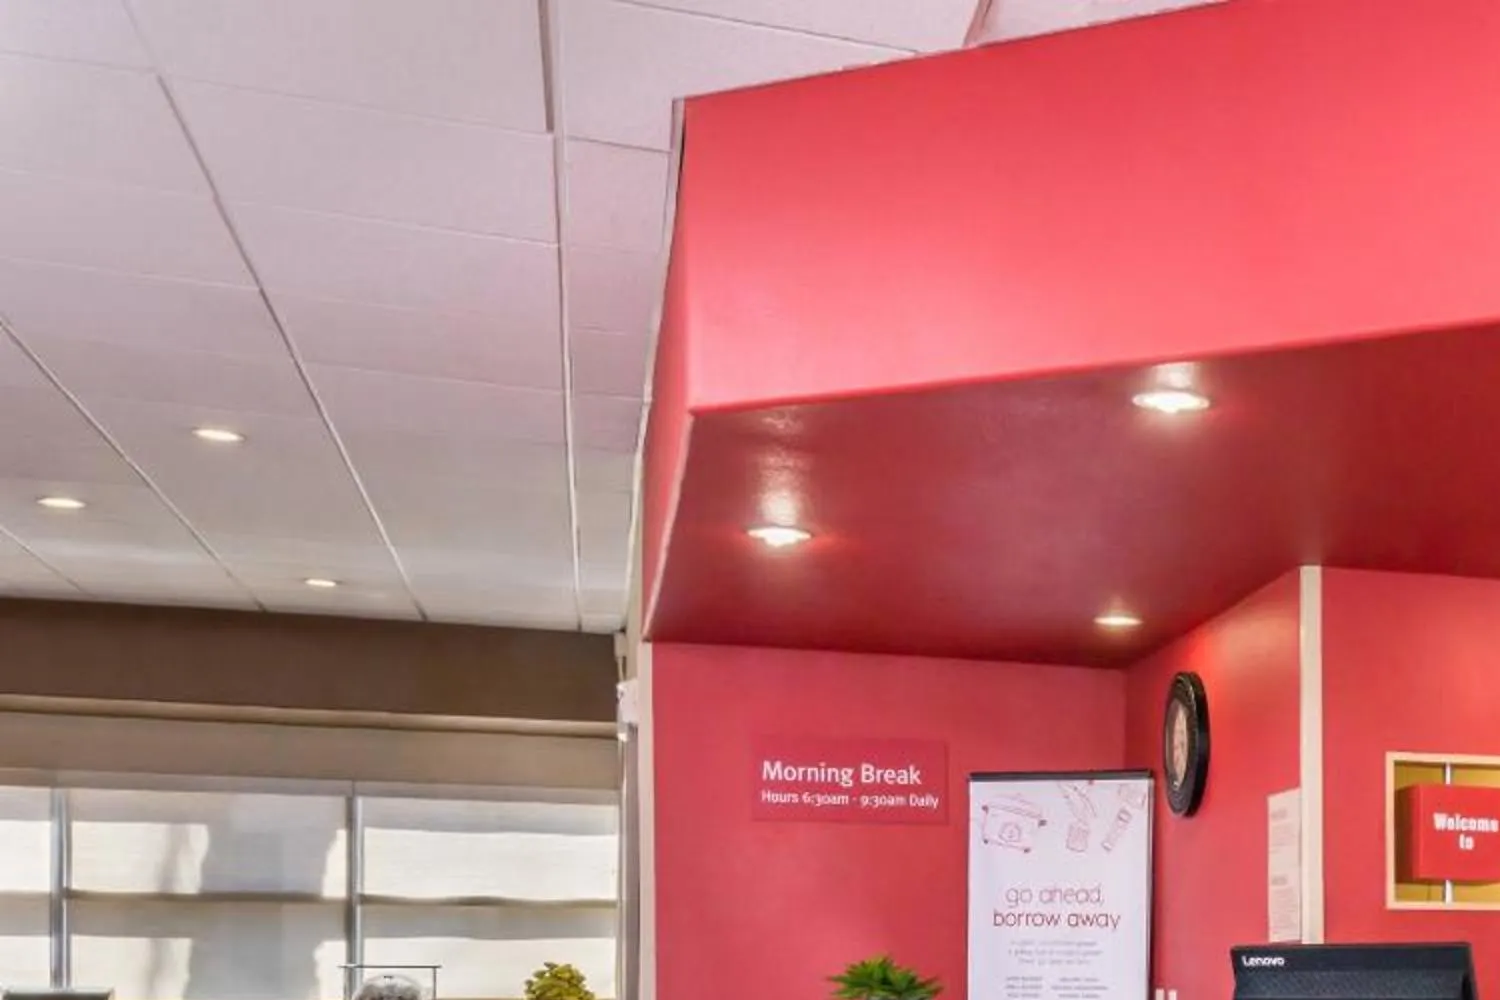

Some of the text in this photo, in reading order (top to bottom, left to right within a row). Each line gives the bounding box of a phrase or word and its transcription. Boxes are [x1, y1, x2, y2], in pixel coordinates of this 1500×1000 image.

[762, 760, 922, 788] Morning Break
[761, 789, 799, 803] Hours
[802, 791, 849, 807] 6:30am
[860, 794, 907, 808] 9:30am
[909, 794, 939, 809] Daily
[1433, 812, 1500, 833] Welcome
[1459, 834, 1474, 850] to
[1005, 882, 1105, 909] go ahead,
[993, 908, 1121, 930] borrow away
[1241, 955, 1285, 967] Lenovo
